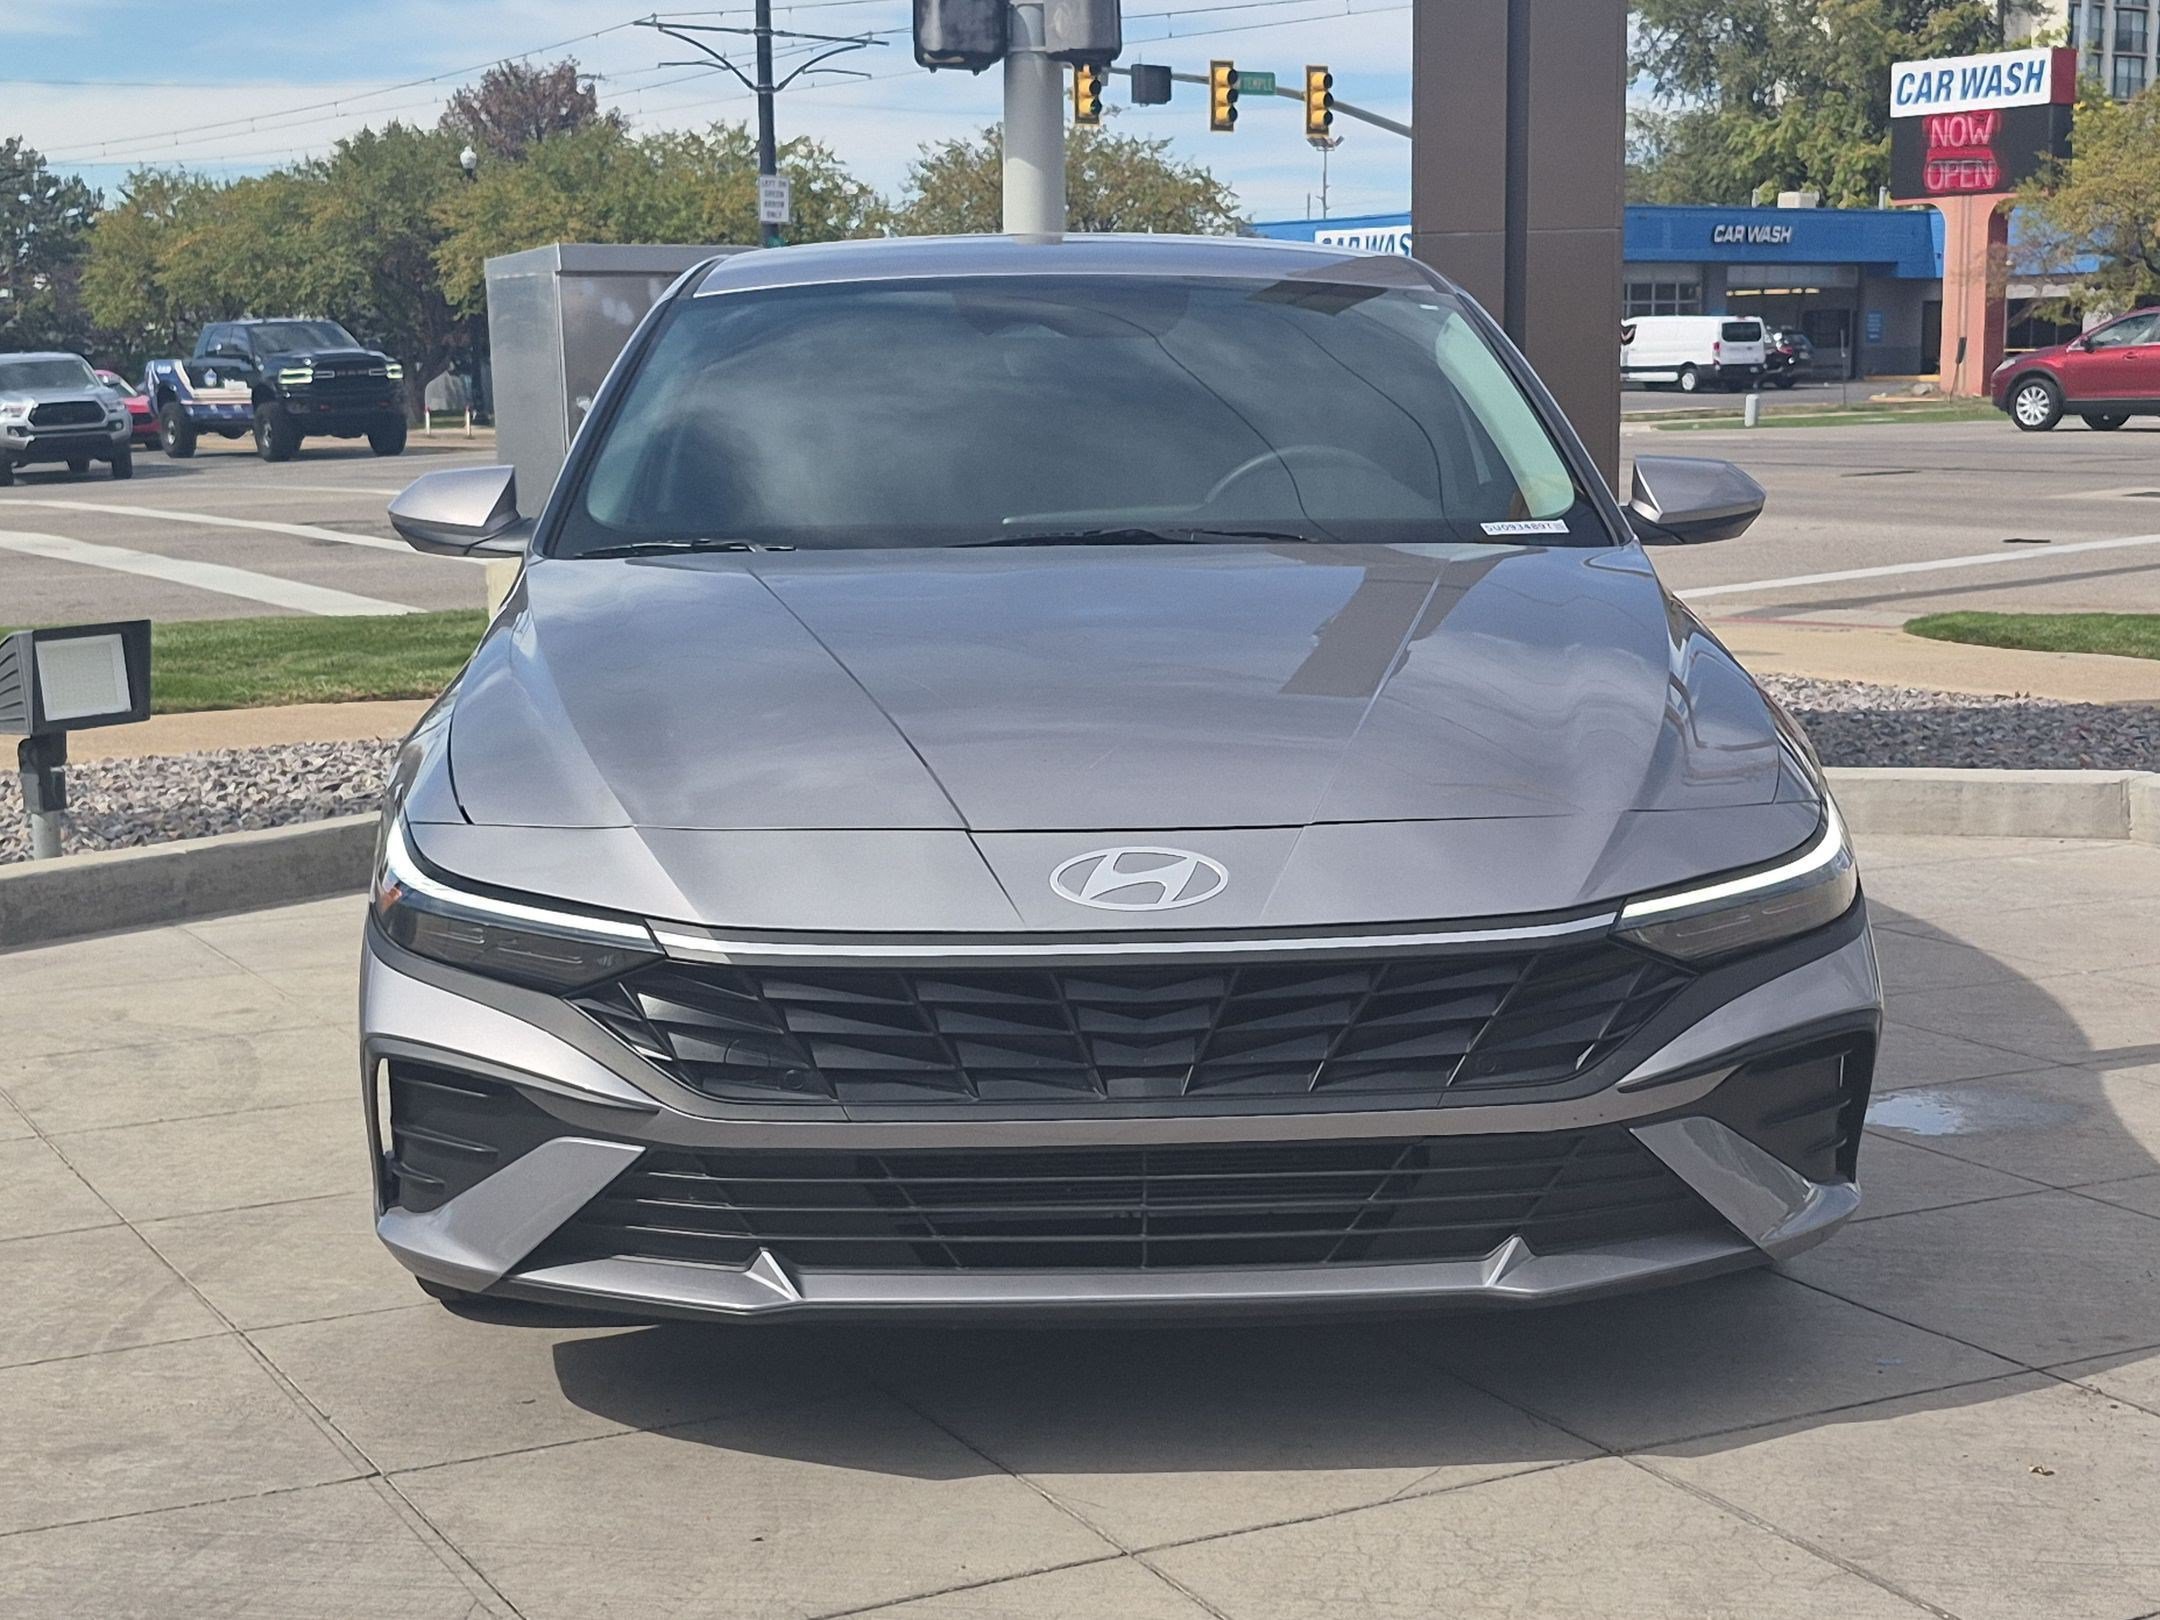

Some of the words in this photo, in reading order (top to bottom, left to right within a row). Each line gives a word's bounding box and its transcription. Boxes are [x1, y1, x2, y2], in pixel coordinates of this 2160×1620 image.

[1896, 69, 1954, 106] CAR
[1959, 60, 2046, 101] WASH
[1930, 114, 1994, 148] NOW
[1926, 159, 1996, 190] OPEN
[1364, 233, 1412, 256] WAS
[1713, 224, 1745, 243] CAR
[1747, 225, 1792, 243] WASH
